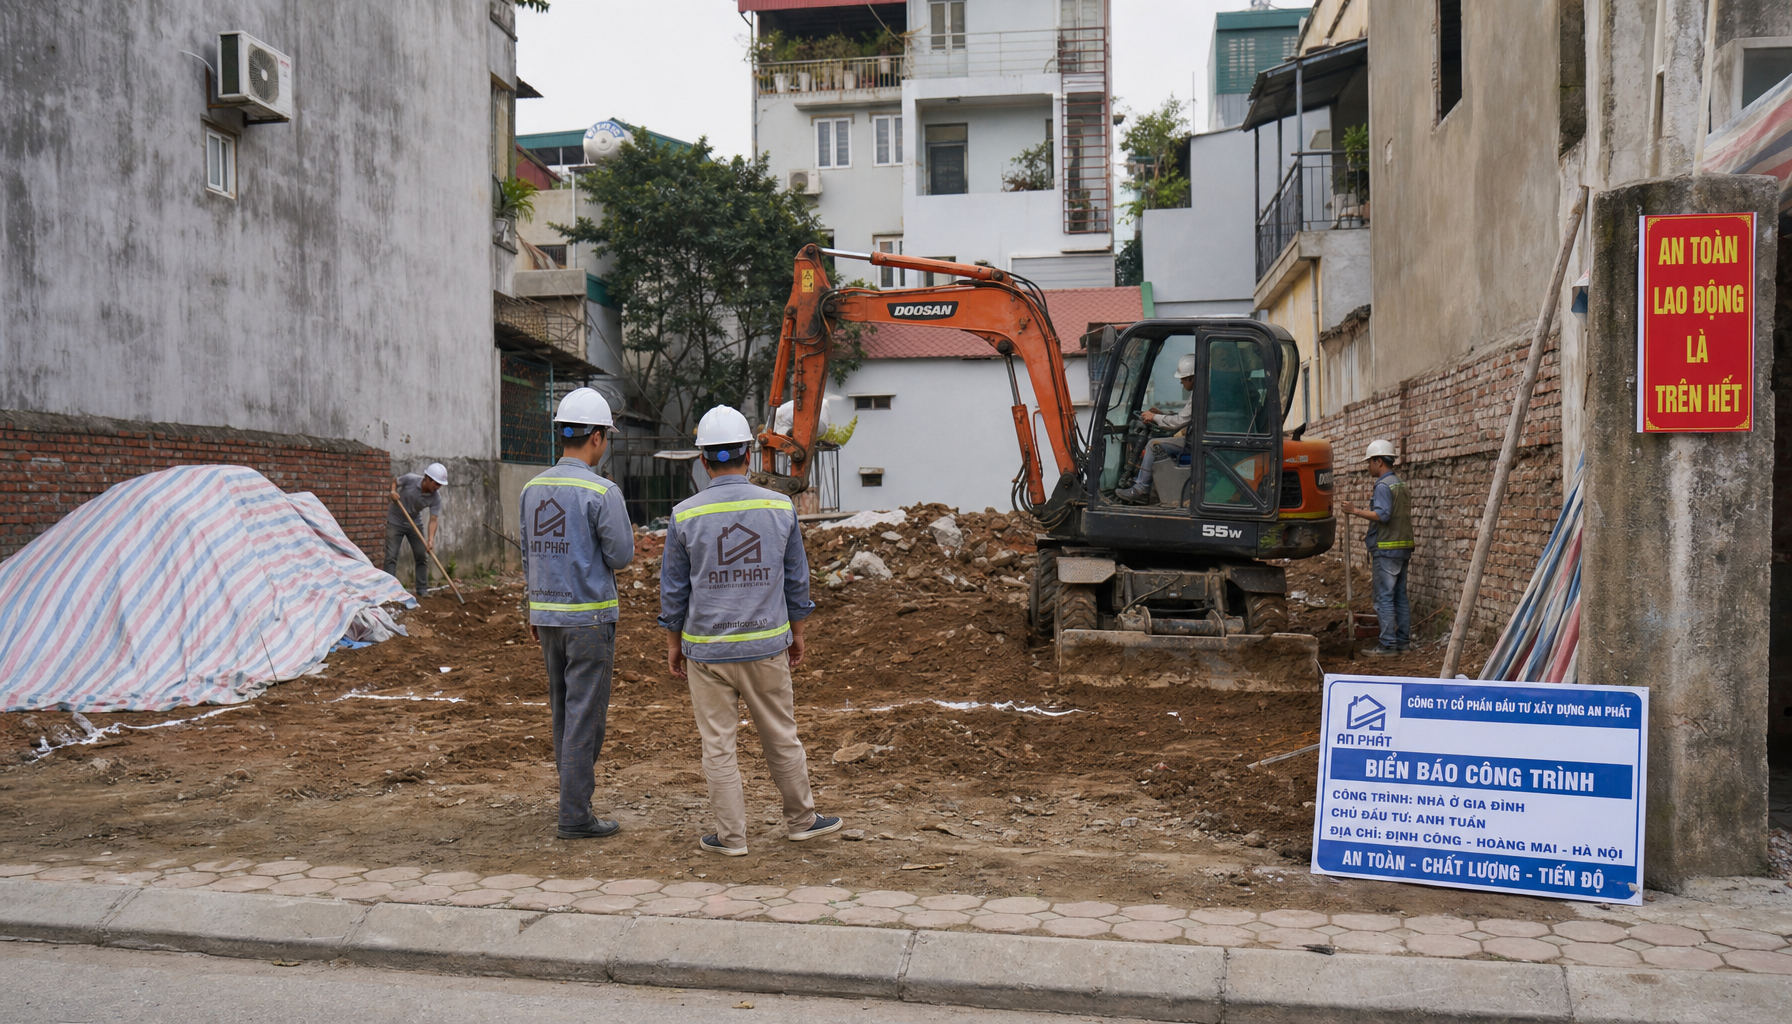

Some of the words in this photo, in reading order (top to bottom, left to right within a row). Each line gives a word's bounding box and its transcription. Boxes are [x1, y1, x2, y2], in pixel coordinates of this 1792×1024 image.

[1658, 237, 1685, 265] AN
[1690, 229, 1738, 264] TOÀN
[893, 304, 952, 316] DOOSAN
[1653, 286, 1687, 314] LAO
[1693, 279, 1744, 320] ĐỘNG
[1686, 328, 1708, 363] LÀ
[1655, 378, 1702, 413] TRÊN
[1707, 374, 1742, 413] HẾT
[544, 539, 570, 554] PHÁT
[708, 570, 728, 583] AN
[732, 564, 771, 582] PHÁT
[1407, 695, 1434, 709] CÔNG
[1436, 699, 1448, 710] TY
[1517, 701, 1532, 714] TƯ
[1533, 701, 1554, 715] XÂY
[1556, 703, 1585, 718] DỰNG
[1587, 705, 1601, 717] AN
[1604, 704, 1632, 718] PHÁT
[1336, 733, 1354, 745] AN
[1357, 732, 1392, 748] PHÁT
[1365, 752, 1409, 780] BIỂN
[1416, 758, 1458, 783] BÁO
[1465, 761, 1522, 788] CÔNG
[1529, 765, 1595, 792] TRÌNH
[1332, 789, 1367, 802] CÔNG
[1371, 791, 1413, 805] TRÌNH:
[1417, 794, 1445, 807] NHÀ
[1463, 799, 1487, 810] GIA
[1490, 799, 1525, 813] ĐÌNH
[1391, 811, 1412, 823] TƯ:
[1416, 814, 1445, 826] ANH
[1330, 826, 1352, 838] ĐỊA
[1386, 831, 1418, 843] ĐỊNH
[1423, 832, 1462, 846] CÔNG
[1476, 837, 1526, 852] HOÀNG
[1530, 842, 1557, 854] MAI
[1572, 844, 1592, 857] HÀ
[1597, 846, 1623, 861] NỘI
[1342, 850, 1362, 867] AN
[1367, 849, 1405, 871] TOÀN
[1422, 854, 1464, 876] CHẤT
[1468, 861, 1520, 883] LƯỢNG
[1538, 863, 1575, 887] TIẾN
[1580, 868, 1605, 893] ĐỘ
